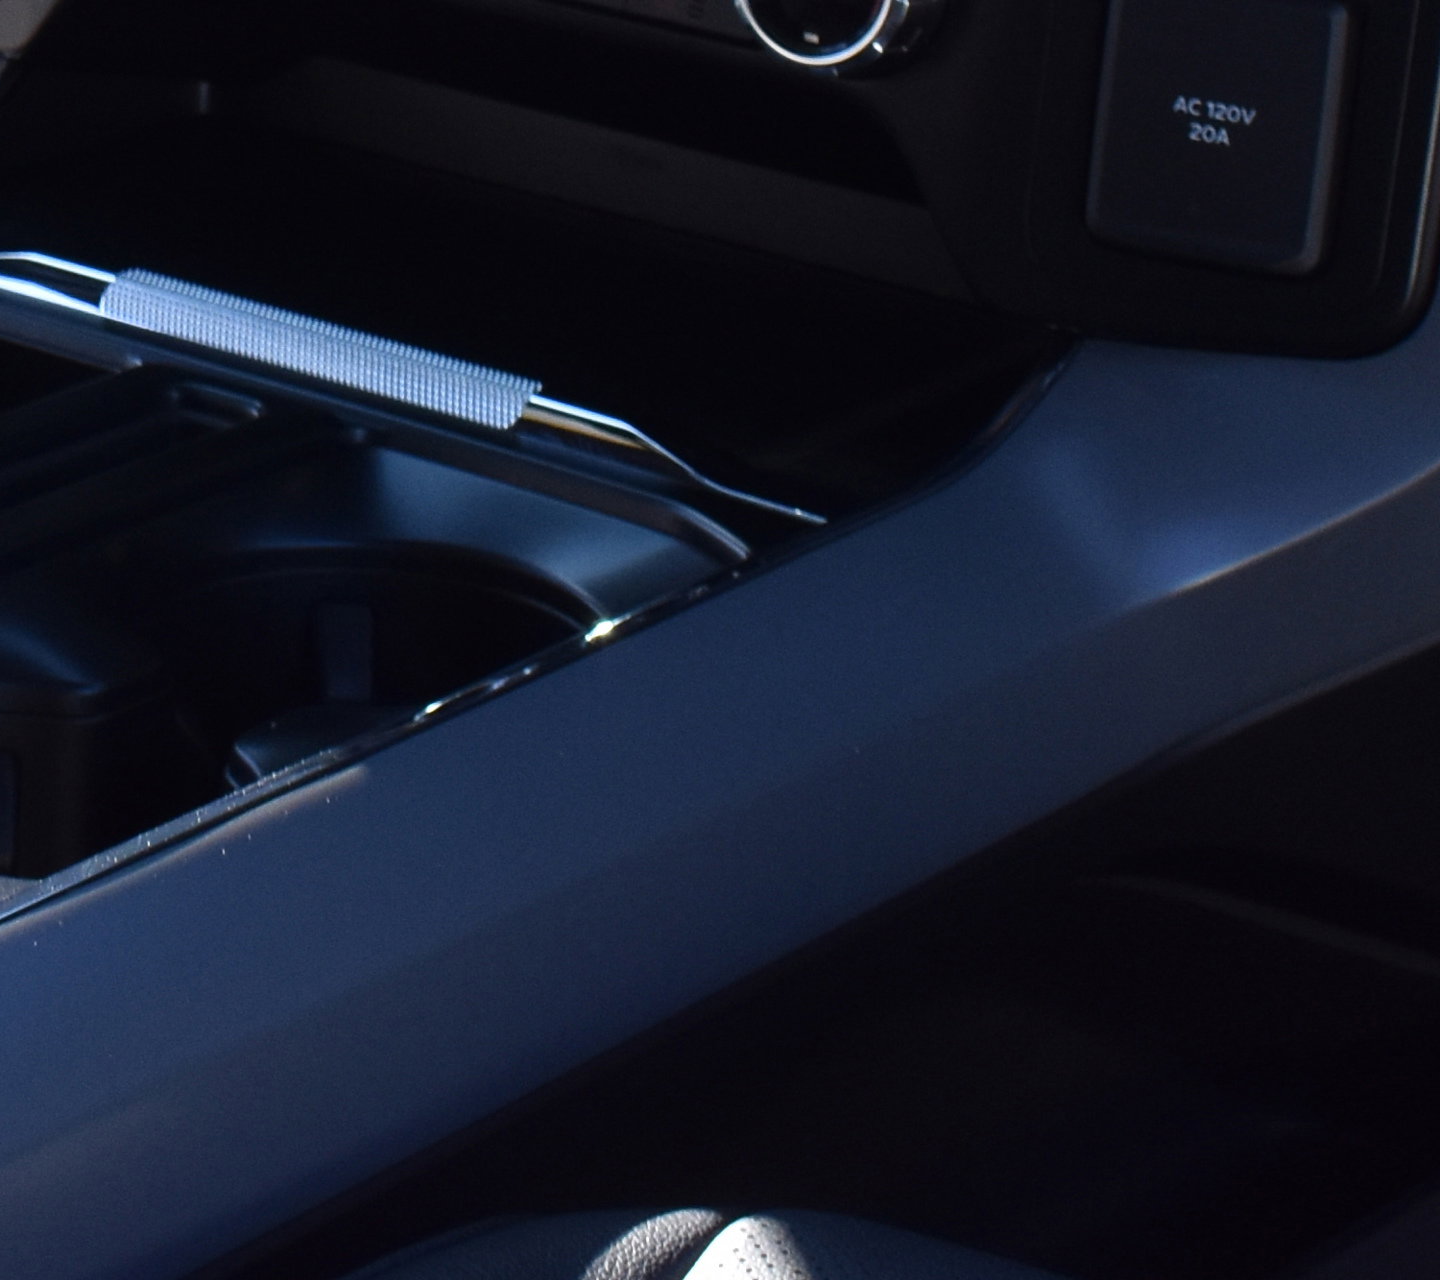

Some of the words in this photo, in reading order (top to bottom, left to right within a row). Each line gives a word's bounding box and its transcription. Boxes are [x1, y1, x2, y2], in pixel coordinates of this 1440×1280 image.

[1173, 94, 1202, 118] AC
[1206, 100, 1256, 128] 120V
[1188, 121, 1231, 147] 20A
